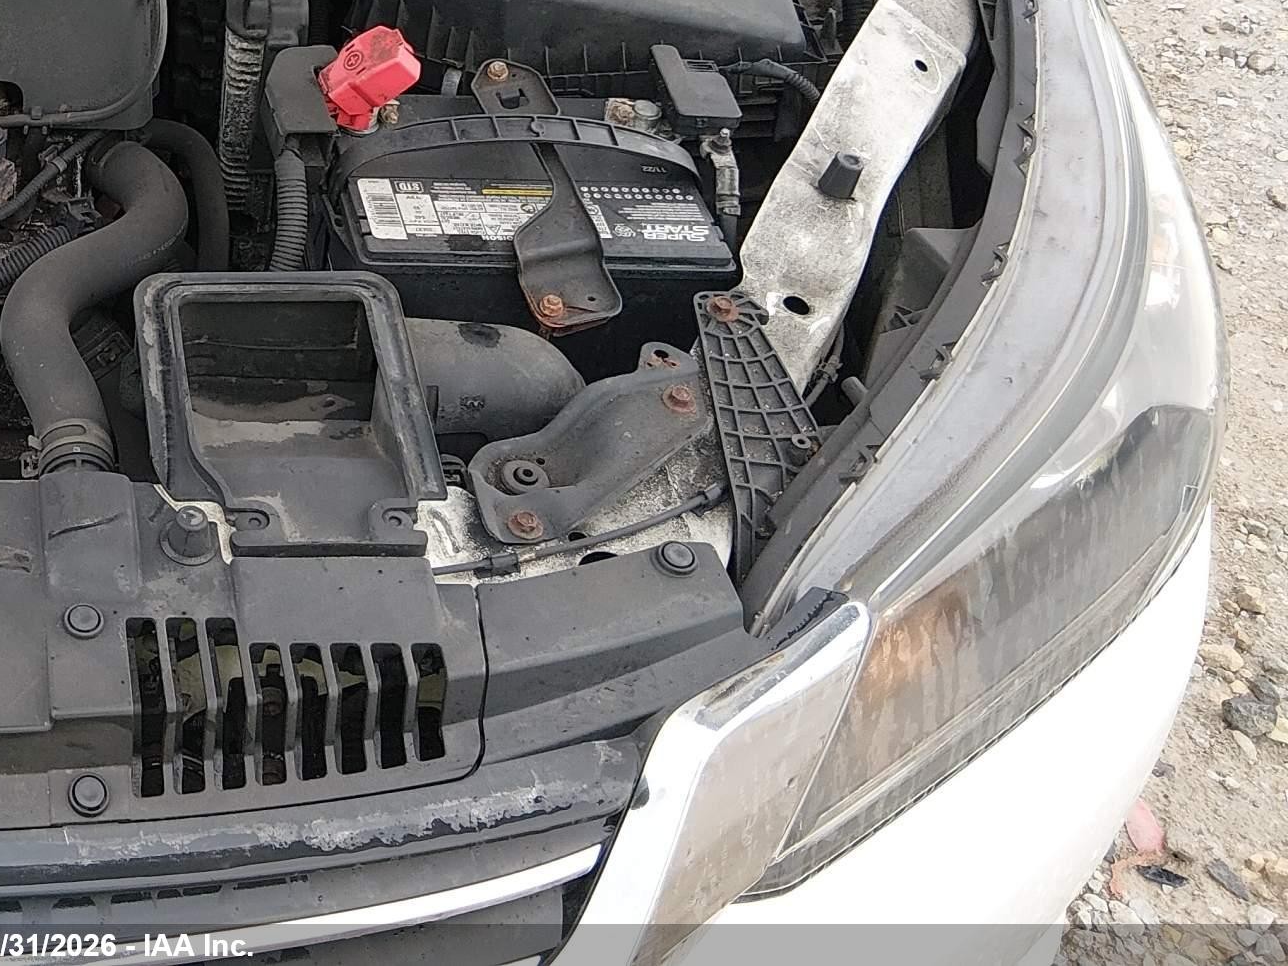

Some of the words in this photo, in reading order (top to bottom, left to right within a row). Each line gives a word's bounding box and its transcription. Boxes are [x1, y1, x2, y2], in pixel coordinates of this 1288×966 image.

[646, 224, 710, 236] START
[480, 234, 514, 242] OISON
[642, 232, 707, 243] SUPER
